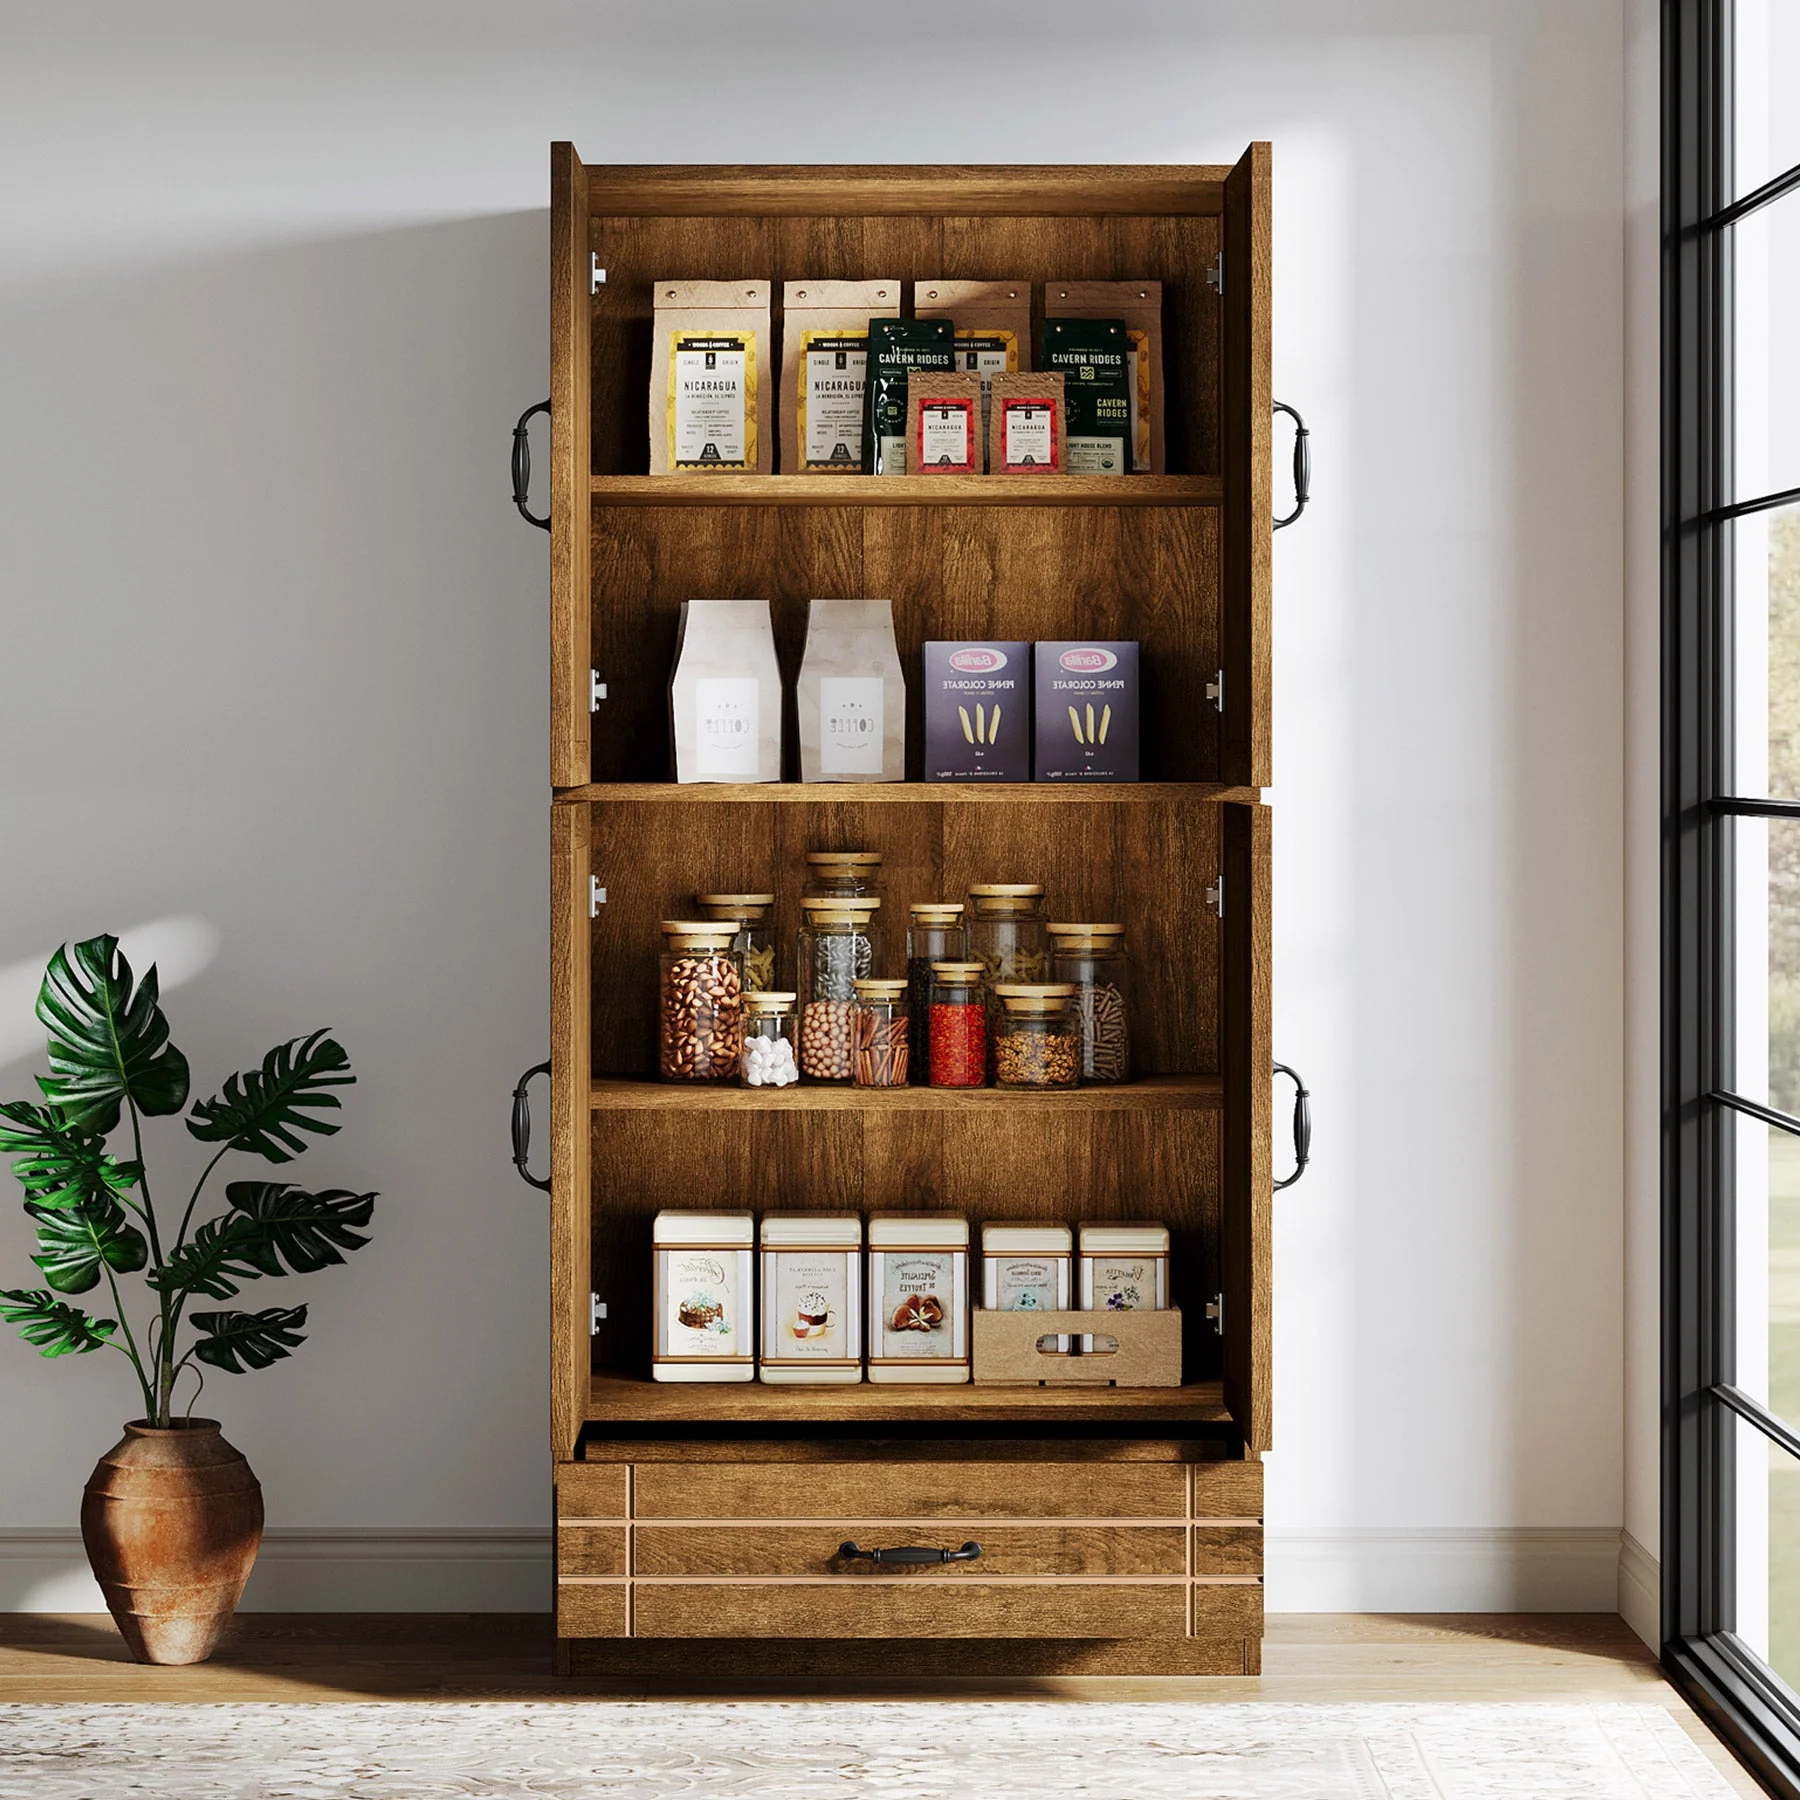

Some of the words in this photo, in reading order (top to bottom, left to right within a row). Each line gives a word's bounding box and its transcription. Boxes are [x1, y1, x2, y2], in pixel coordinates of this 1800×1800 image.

[879, 353, 914, 364] CAVERN
[916, 354, 949, 365] RIDGES
[1052, 353, 1087, 364] CAVERN
[1089, 354, 1122, 365] RIDGES
[683, 380, 737, 391] NICARAGUA
[1096, 398, 1127, 408] CAVERN
[1096, 408, 1128, 418] RIDGES
[706, 445, 715, 454] 12
[836, 445, 845, 454] 12
